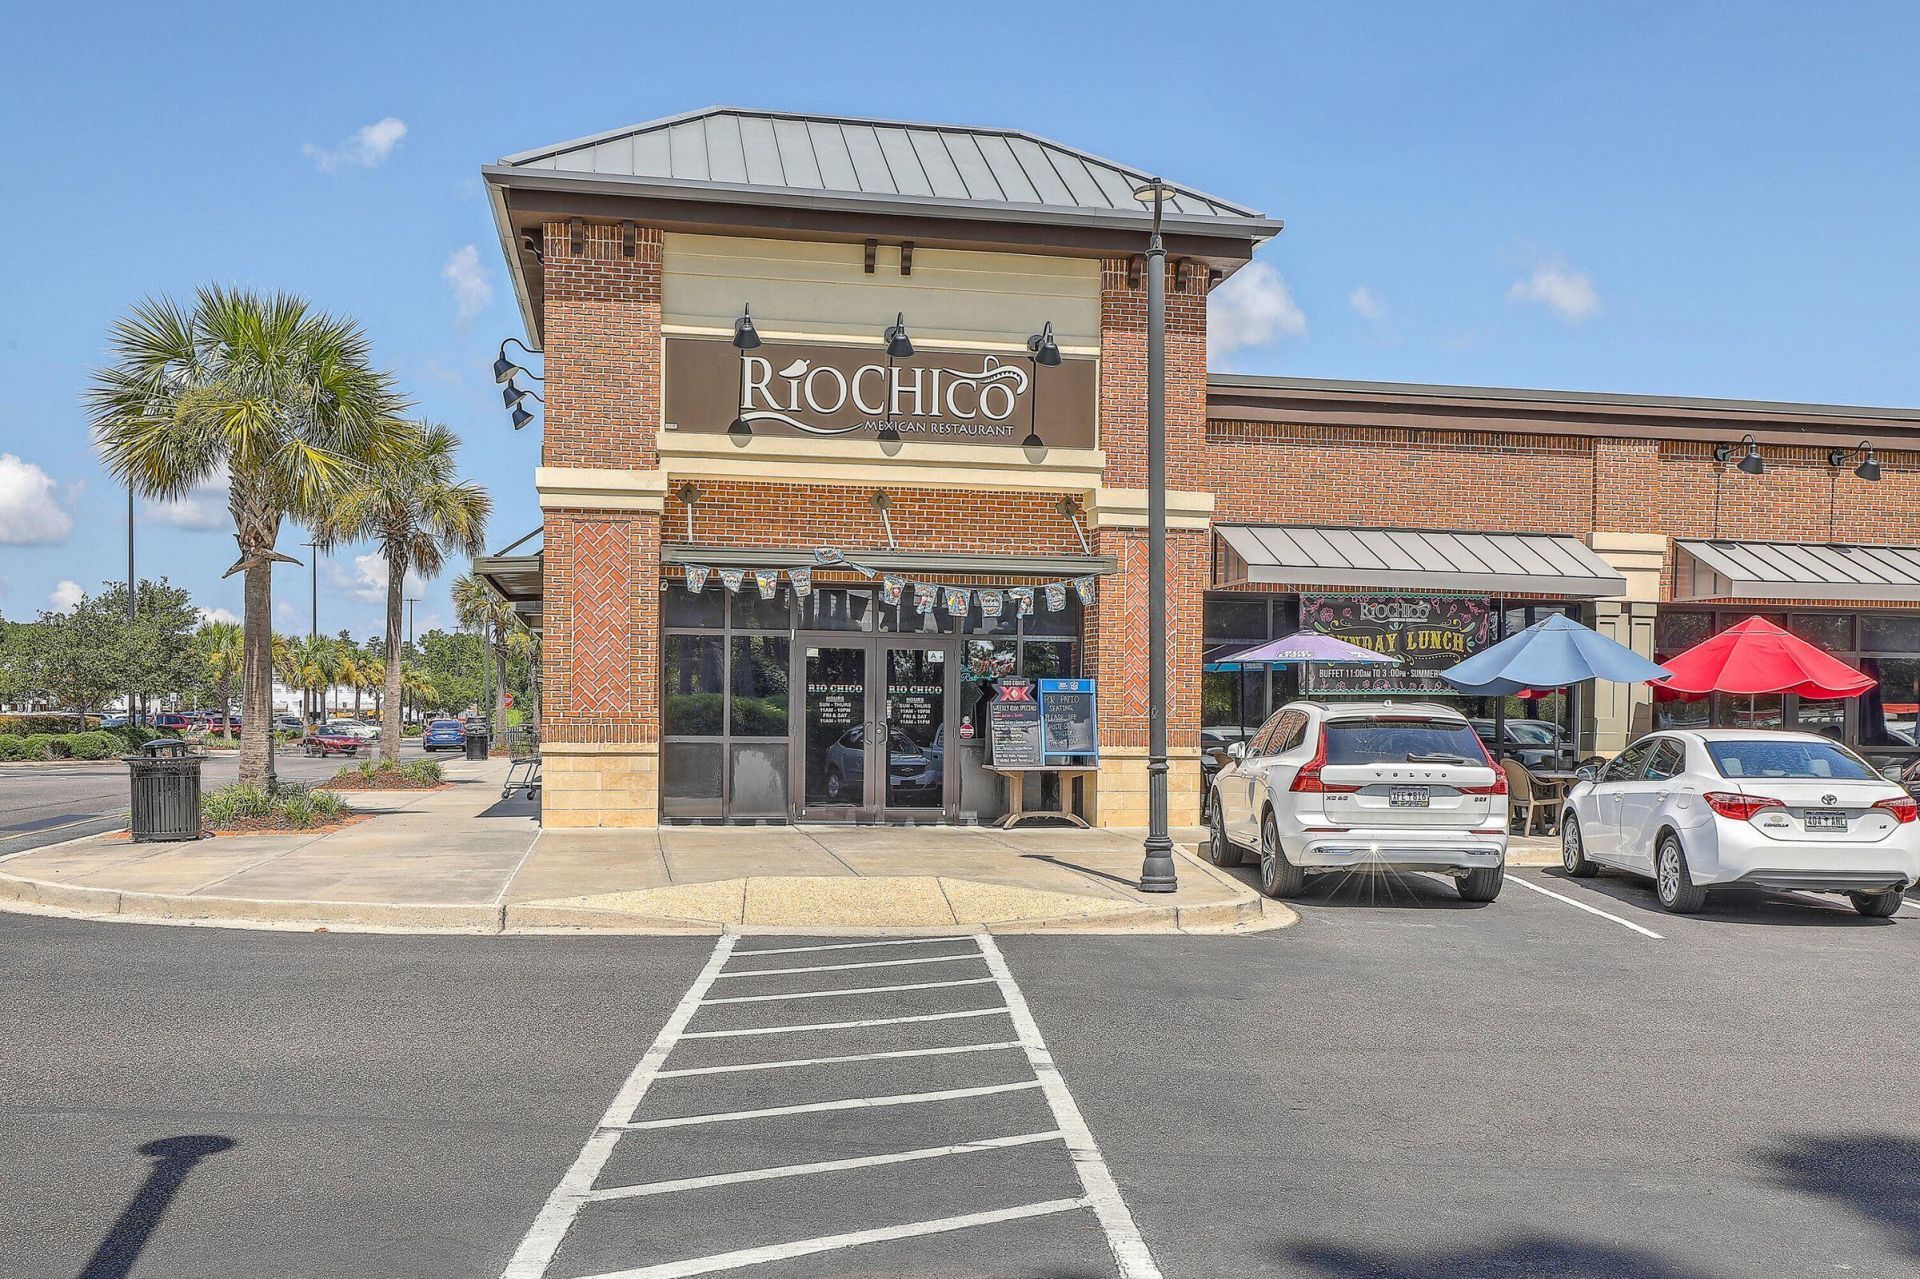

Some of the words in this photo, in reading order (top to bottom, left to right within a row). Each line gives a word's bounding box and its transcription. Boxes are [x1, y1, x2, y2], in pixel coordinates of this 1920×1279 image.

[864, 420, 926, 432] MEXICAN
[931, 422, 1015, 437] RESTAURANT
[1407, 630, 1465, 653] LUNCH
[1319, 669, 1343, 678] BUFFET
[1346, 669, 1371, 678] 11:00AM
[1372, 669, 1380, 678] TO
[808, 684, 827, 693] RIO
[830, 684, 863, 693] CHICO
[888, 685, 907, 694] RIO
[910, 685, 943, 694] CHICO
[999, 686, 1030, 701] XX
[1060, 695, 1080, 703] PATIO
[1392, 791, 1406, 800] XFE
[1412, 791, 1426, 800] 816
[1807, 816, 1821, 825] 404
